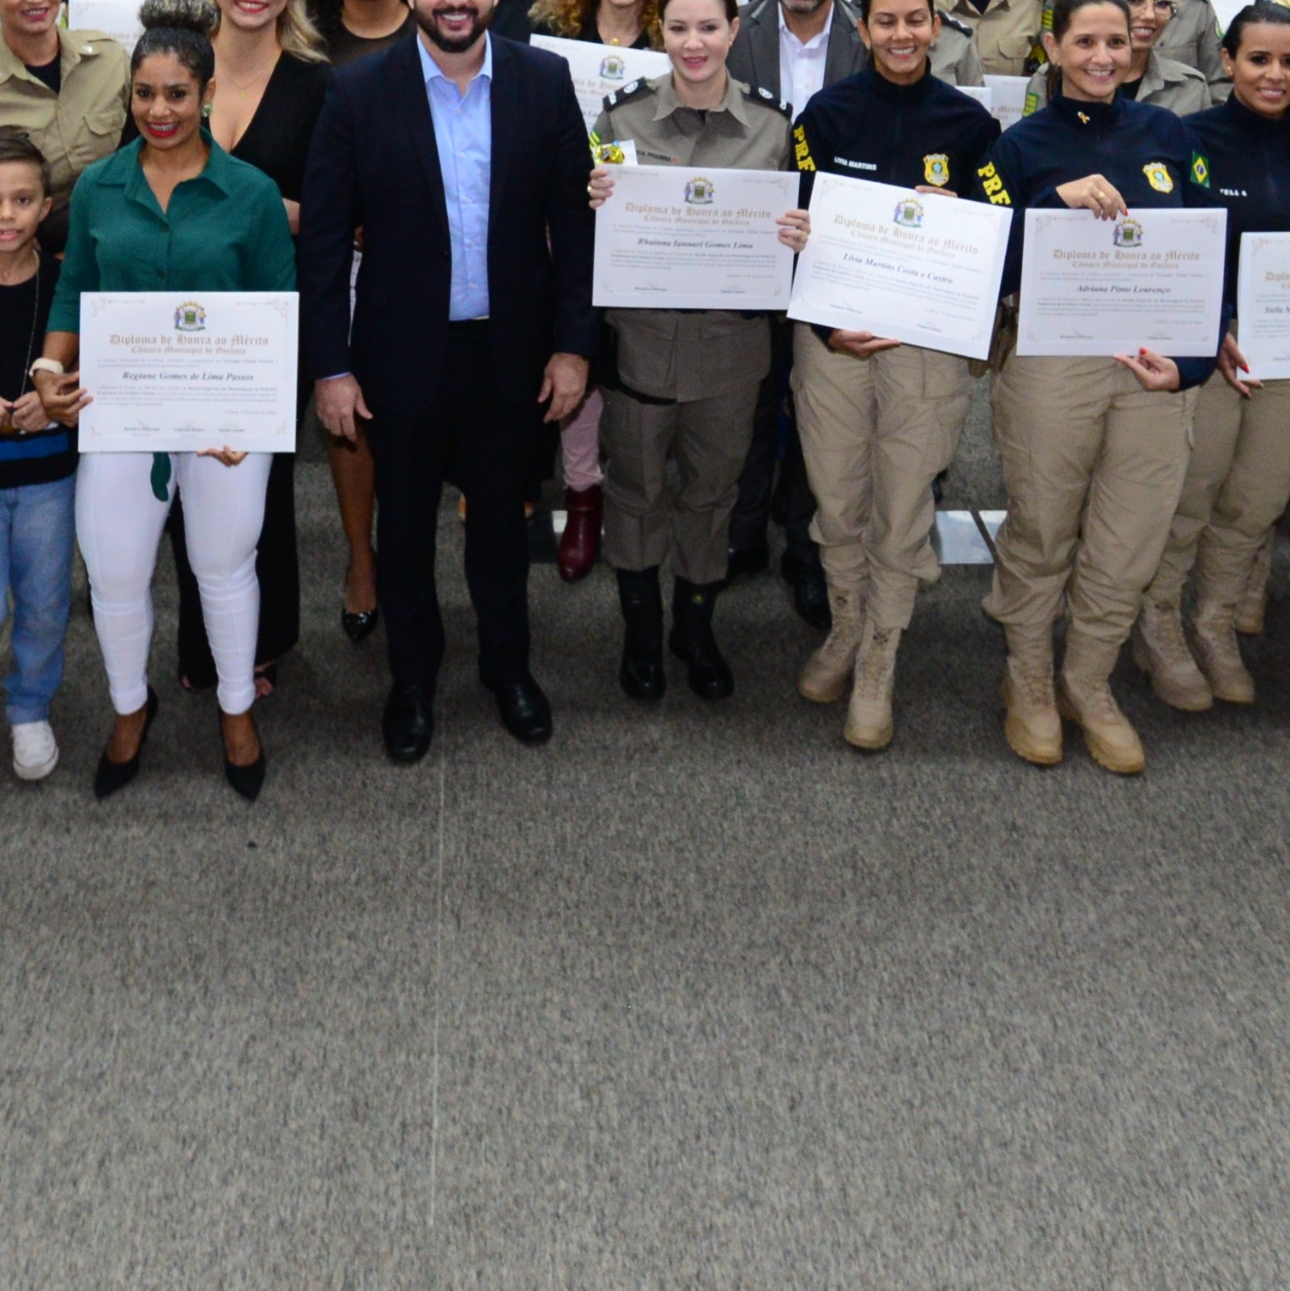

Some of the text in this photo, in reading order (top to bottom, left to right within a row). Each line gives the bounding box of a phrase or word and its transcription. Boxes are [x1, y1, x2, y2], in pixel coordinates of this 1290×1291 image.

[794, 124, 816, 172] PRF
[849, 160, 877, 171] MARTINS
[977, 161, 1011, 205] PRF
[625, 202, 667, 215] Diploma
[686, 206, 718, 217] Honra
[736, 208, 771, 218] Mérito
[834, 215, 876, 232] Diploma
[893, 227, 925, 242] Honra
[942, 238, 978, 254] Mérito
[1053, 249, 1096, 260] Diploma
[1115, 250, 1147, 261] Honra
[1165, 250, 1200, 261] Mérito
[843, 253, 863, 265] Lívia
[864, 258, 895, 271] Martins
[897, 265, 918, 276] Costa
[927, 271, 953, 284] Castro
[110, 334, 157, 345] Diploma
[176, 334, 211, 345] Honra
[231, 333, 268, 345] Mérito
[123, 372, 157, 382] Regiane
[160, 372, 187, 380] Gomes
[202, 372, 223, 381] Lima
[226, 373, 253, 381] Passos
